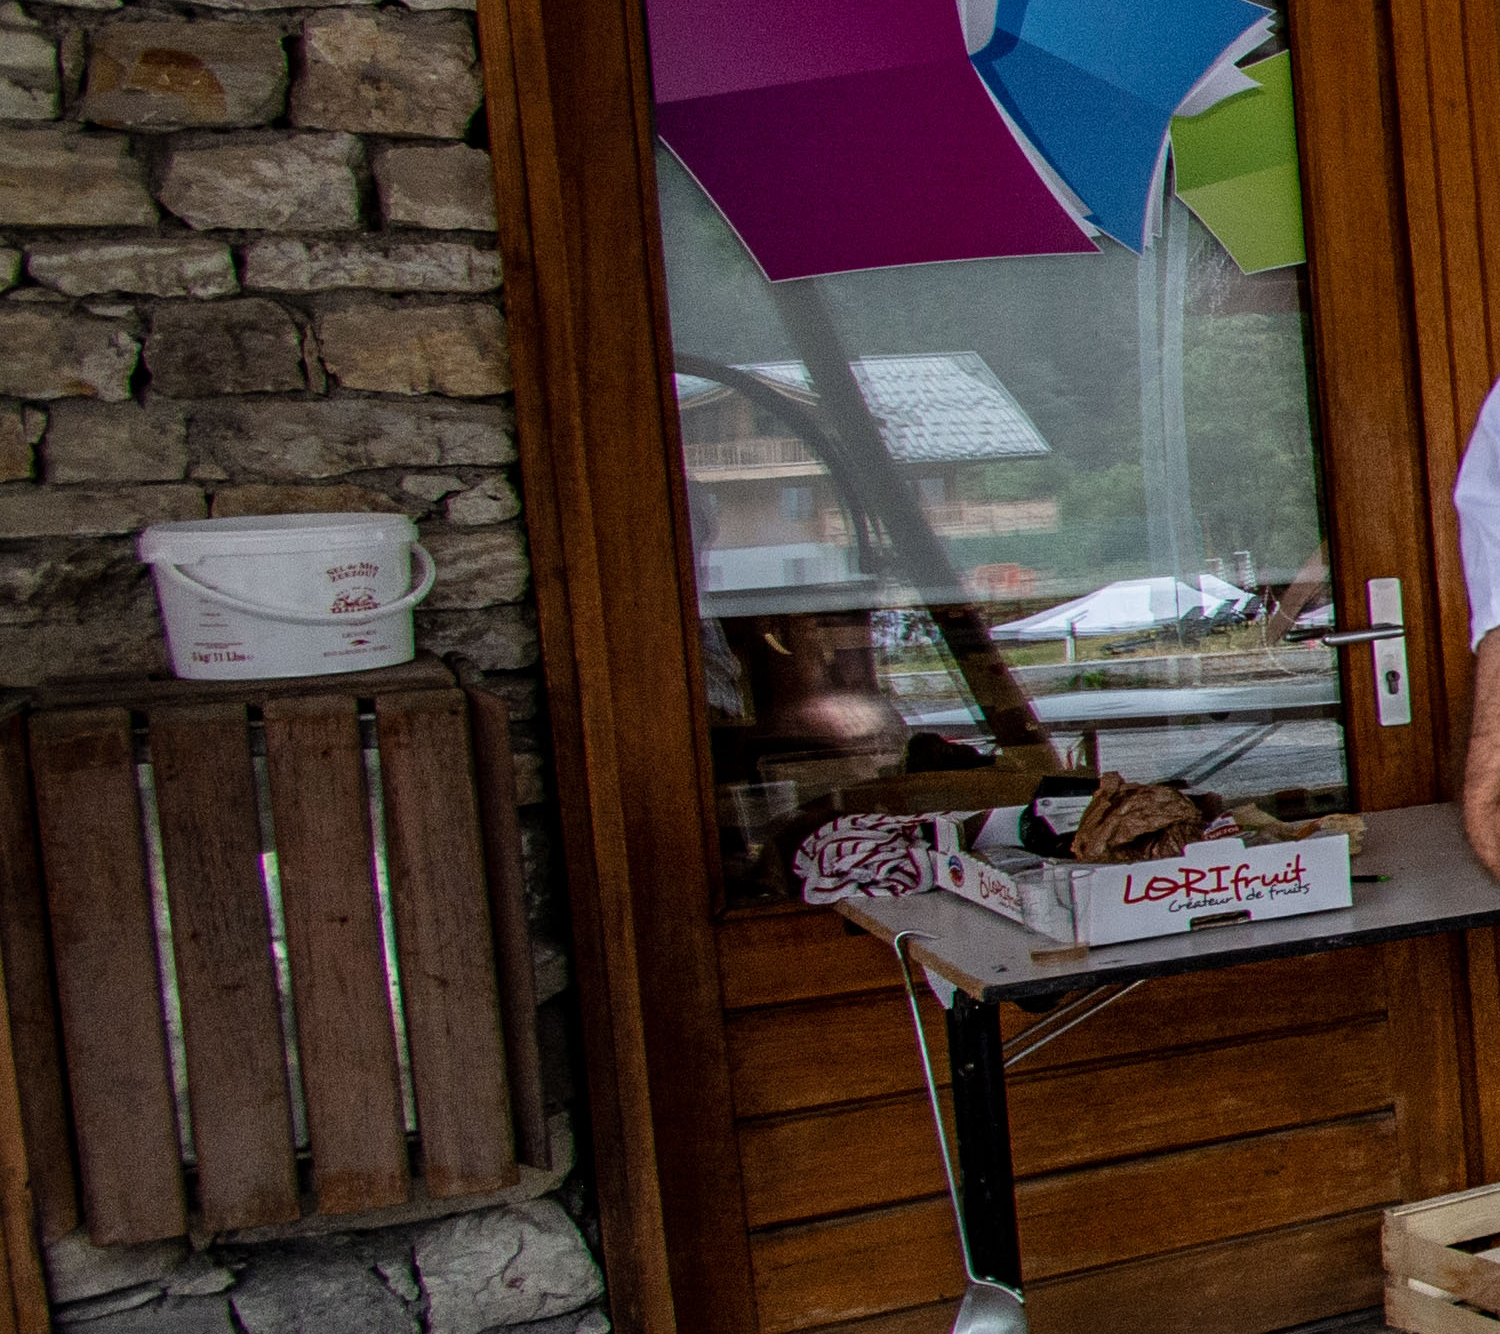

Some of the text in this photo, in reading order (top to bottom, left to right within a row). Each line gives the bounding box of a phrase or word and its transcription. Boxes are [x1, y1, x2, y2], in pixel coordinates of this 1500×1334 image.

[1168, 883, 1310, 913] Créateur de fruits
